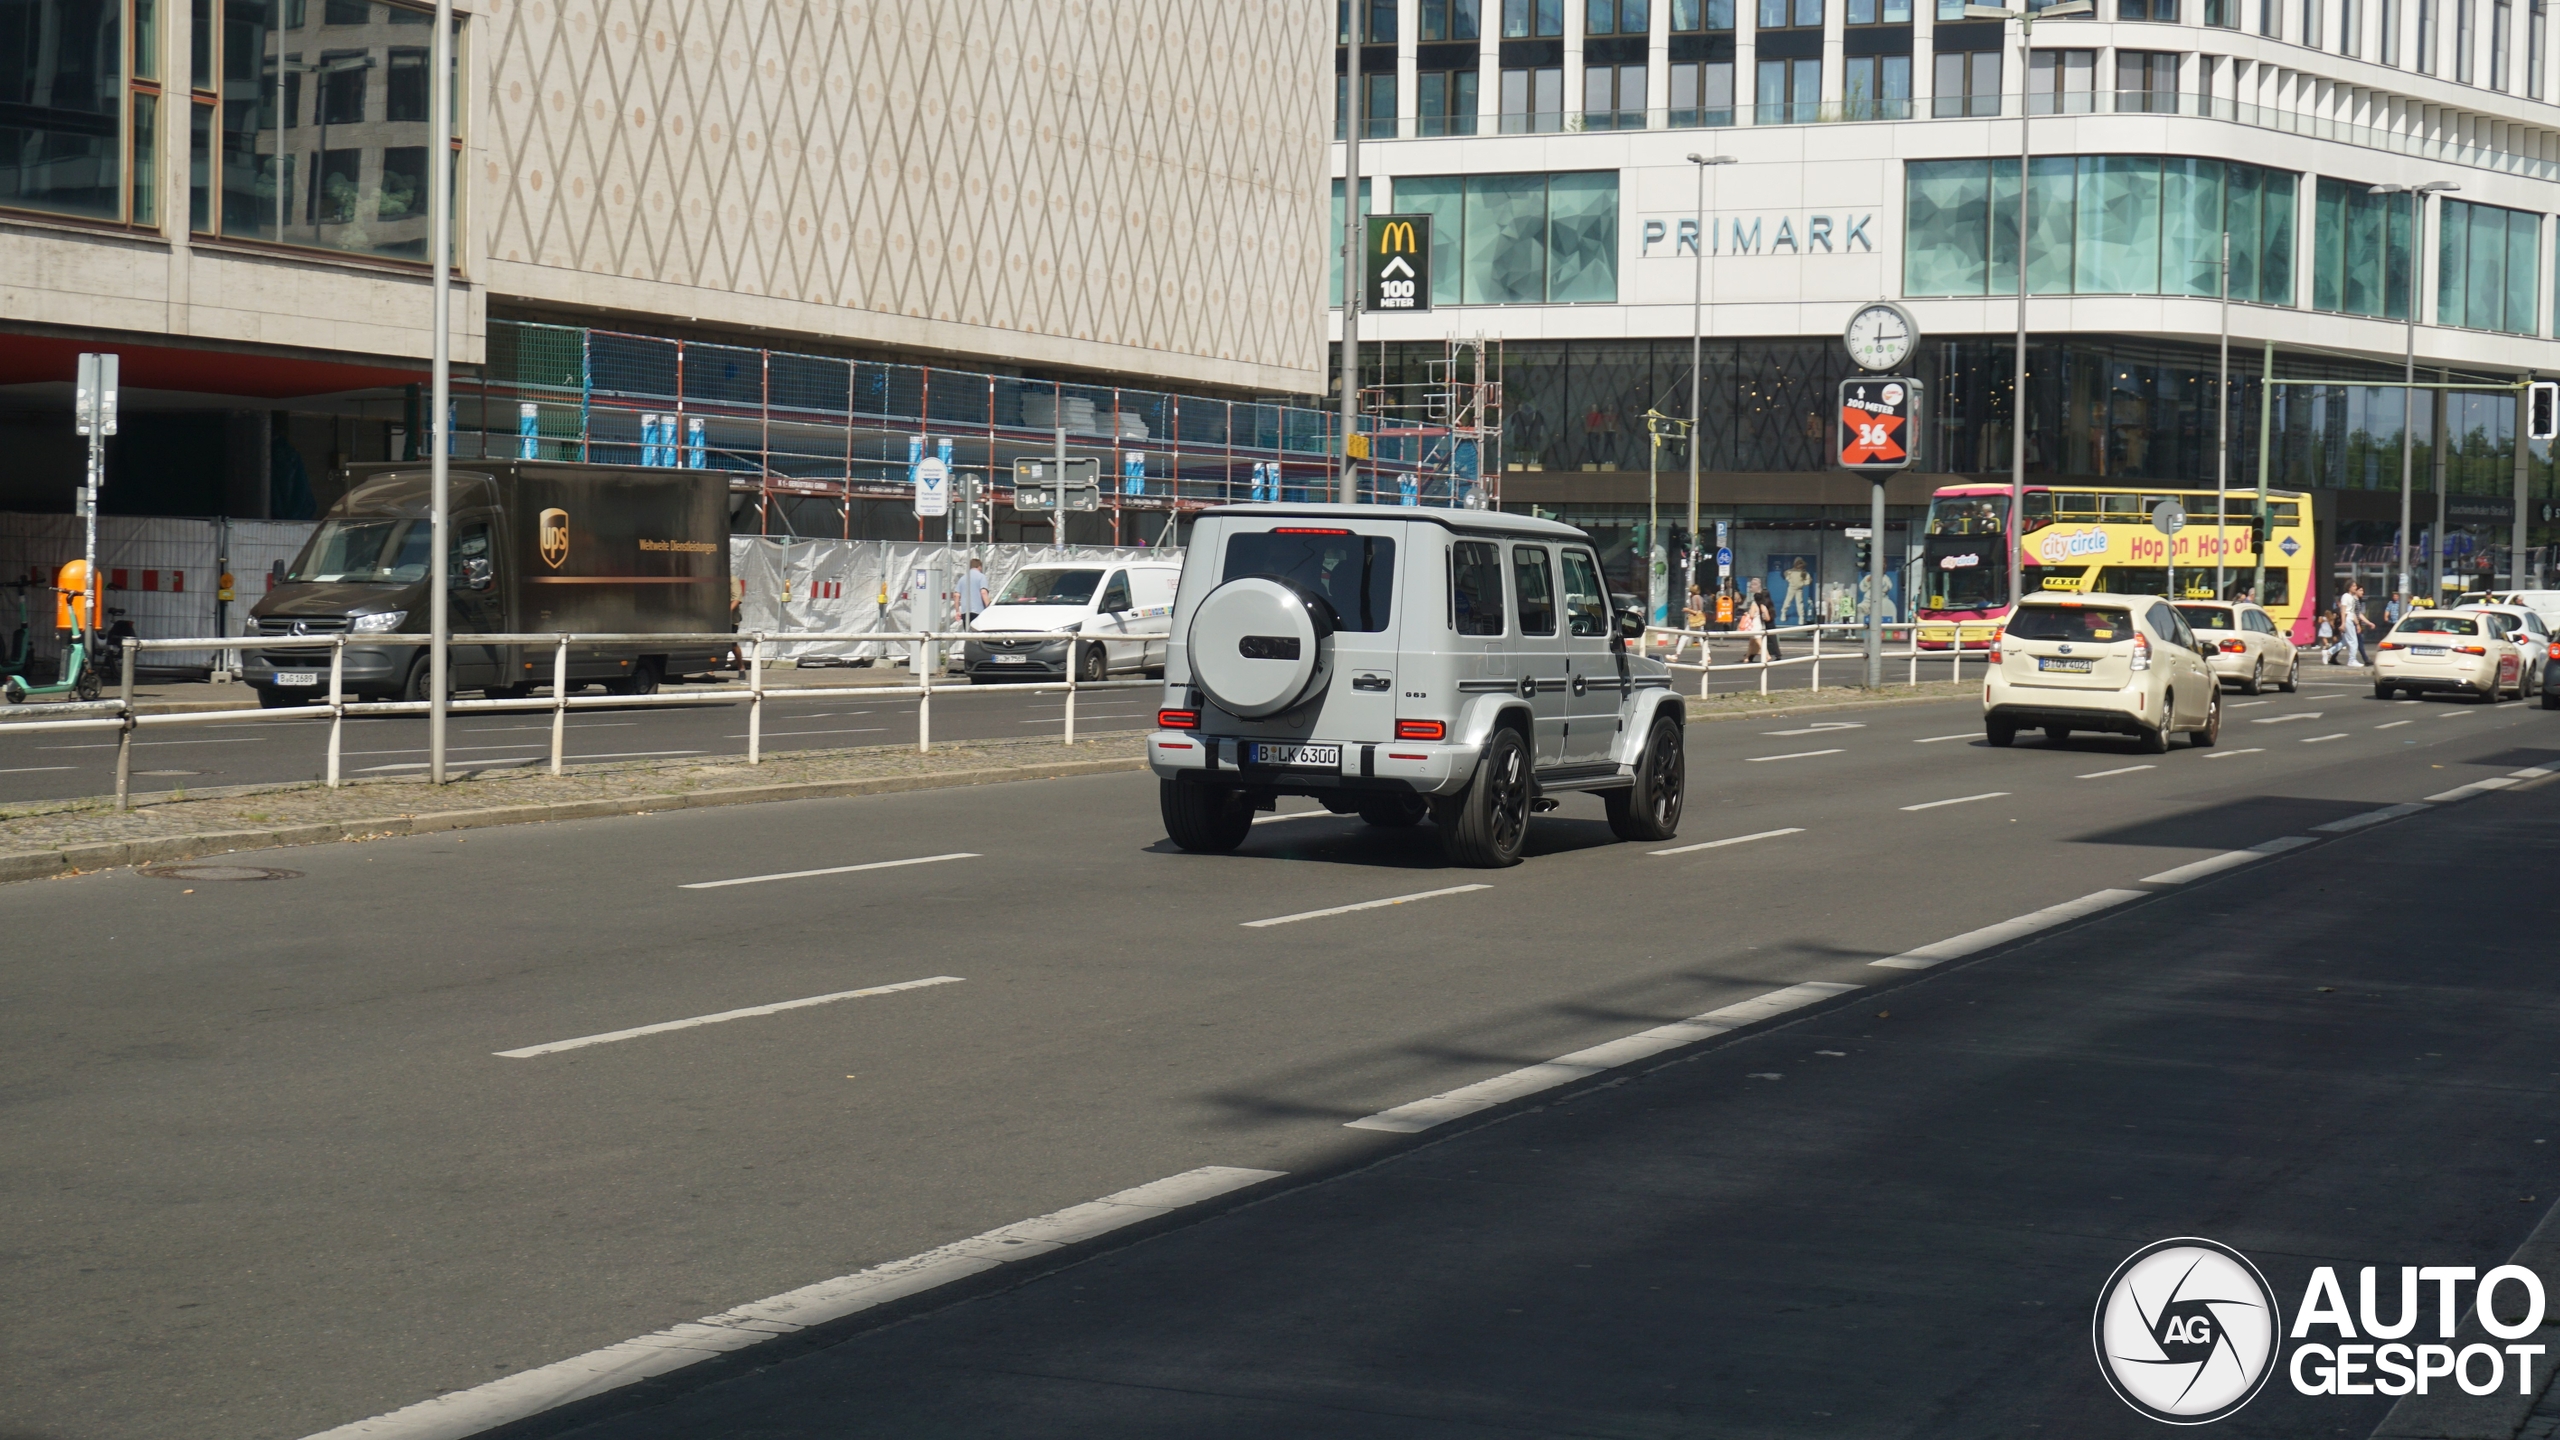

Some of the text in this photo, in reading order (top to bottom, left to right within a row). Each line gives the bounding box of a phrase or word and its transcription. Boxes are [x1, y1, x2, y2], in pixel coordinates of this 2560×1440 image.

[1643, 214, 1872, 255] PRIMARK
[1380, 280, 1415, 298] 100
[1380, 298, 1415, 308] METER
[1846, 398, 1895, 415] 200 METER
[1859, 423, 1888, 446] 36
[543, 526, 567, 558] ups
[639, 539, 717, 554] Weltweite Dienstleistungen
[2044, 531, 2105, 557] city circle
[2131, 536, 2163, 563] Hop
[1260, 746, 1269, 760] B
[1279, 747, 1297, 762] LK
[1300, 748, 1336, 763] 6300
